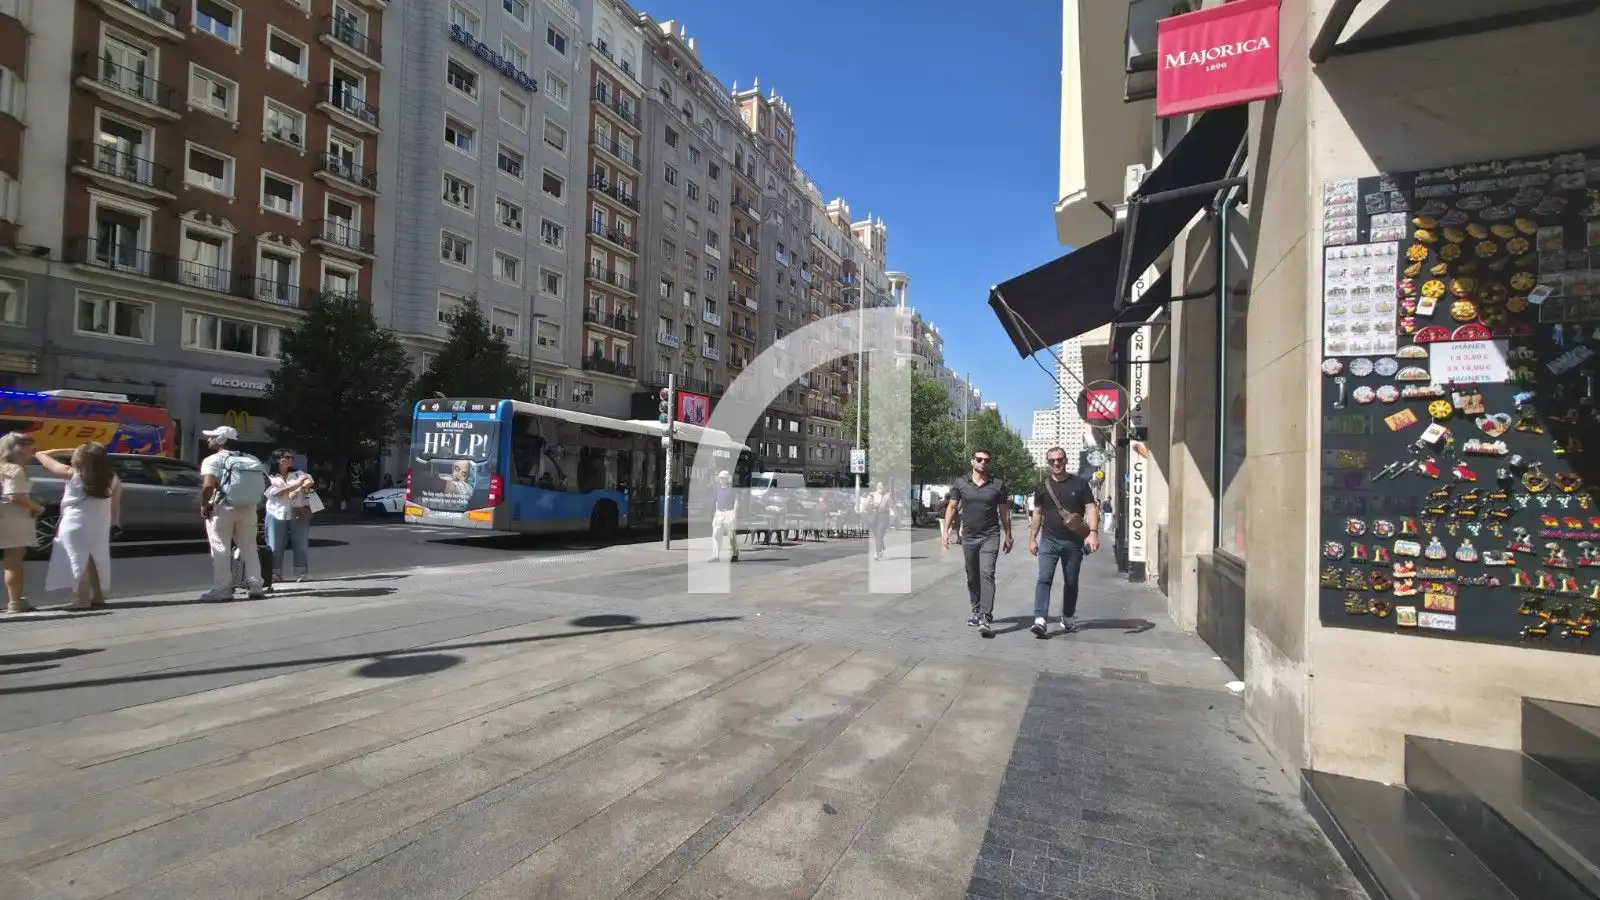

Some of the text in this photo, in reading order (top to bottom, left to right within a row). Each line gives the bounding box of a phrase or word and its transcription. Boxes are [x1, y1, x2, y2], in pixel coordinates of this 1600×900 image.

[451, 24, 537, 93] SEGUROS
[1134, 355, 1143, 411] CHURROS
[1132, 462, 1143, 541] CHURROS
